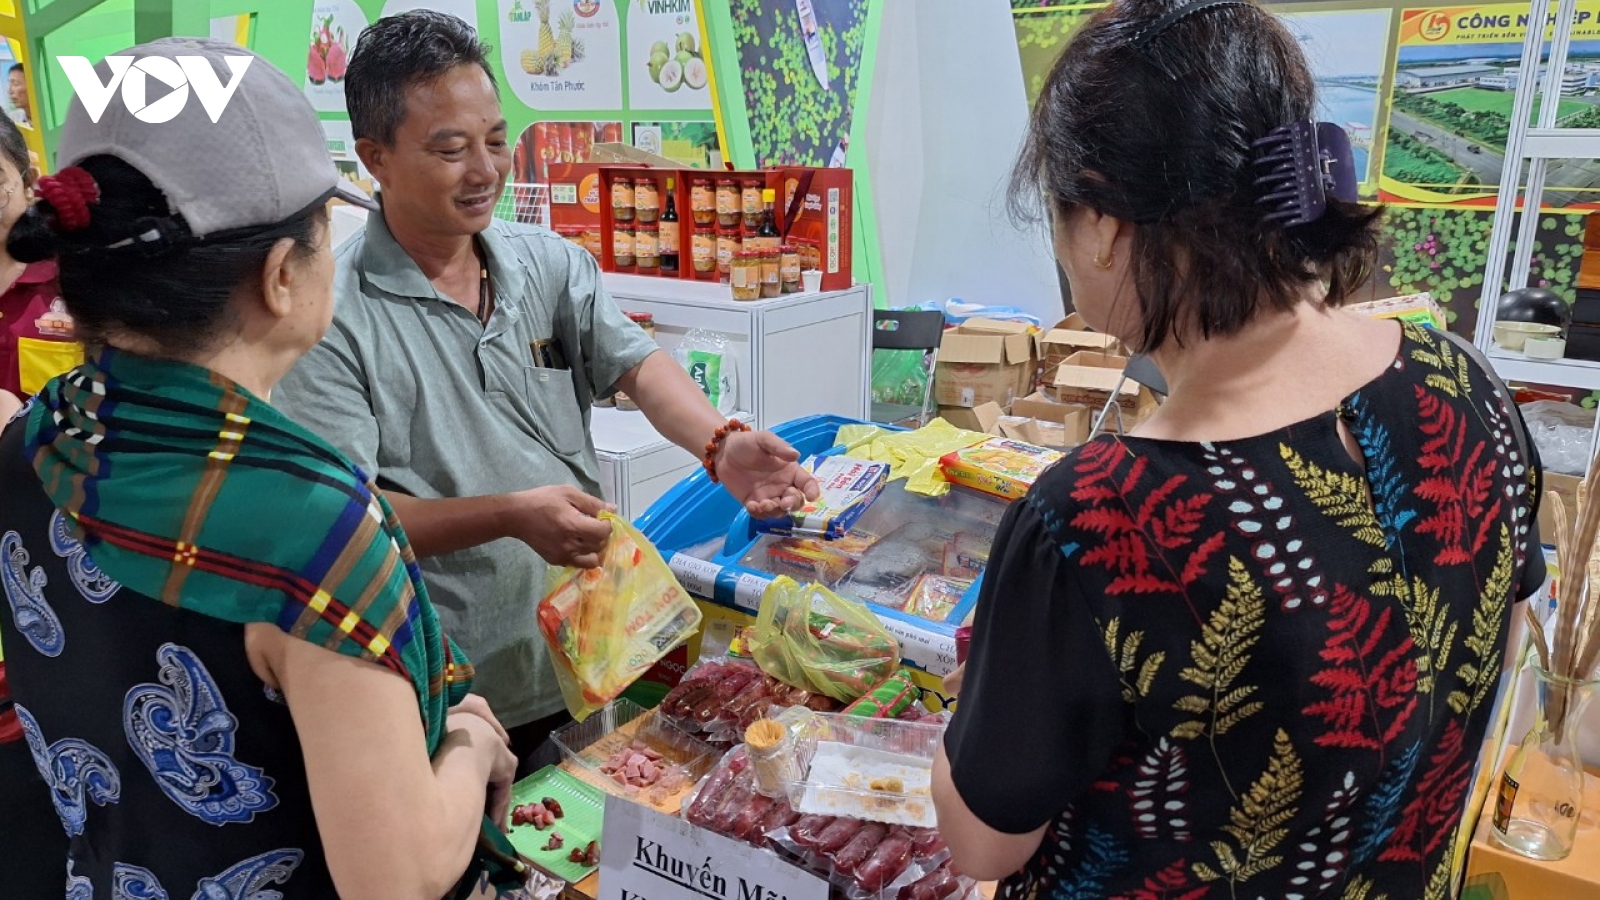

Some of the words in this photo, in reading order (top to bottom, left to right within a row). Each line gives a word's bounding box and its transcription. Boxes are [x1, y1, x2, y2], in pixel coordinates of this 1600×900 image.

[1457, 13, 1510, 28] CÔNG
[530, 82, 549, 91] Khóm
[550, 81, 563, 91] Tân
[635, 835, 727, 897] Khuyến
